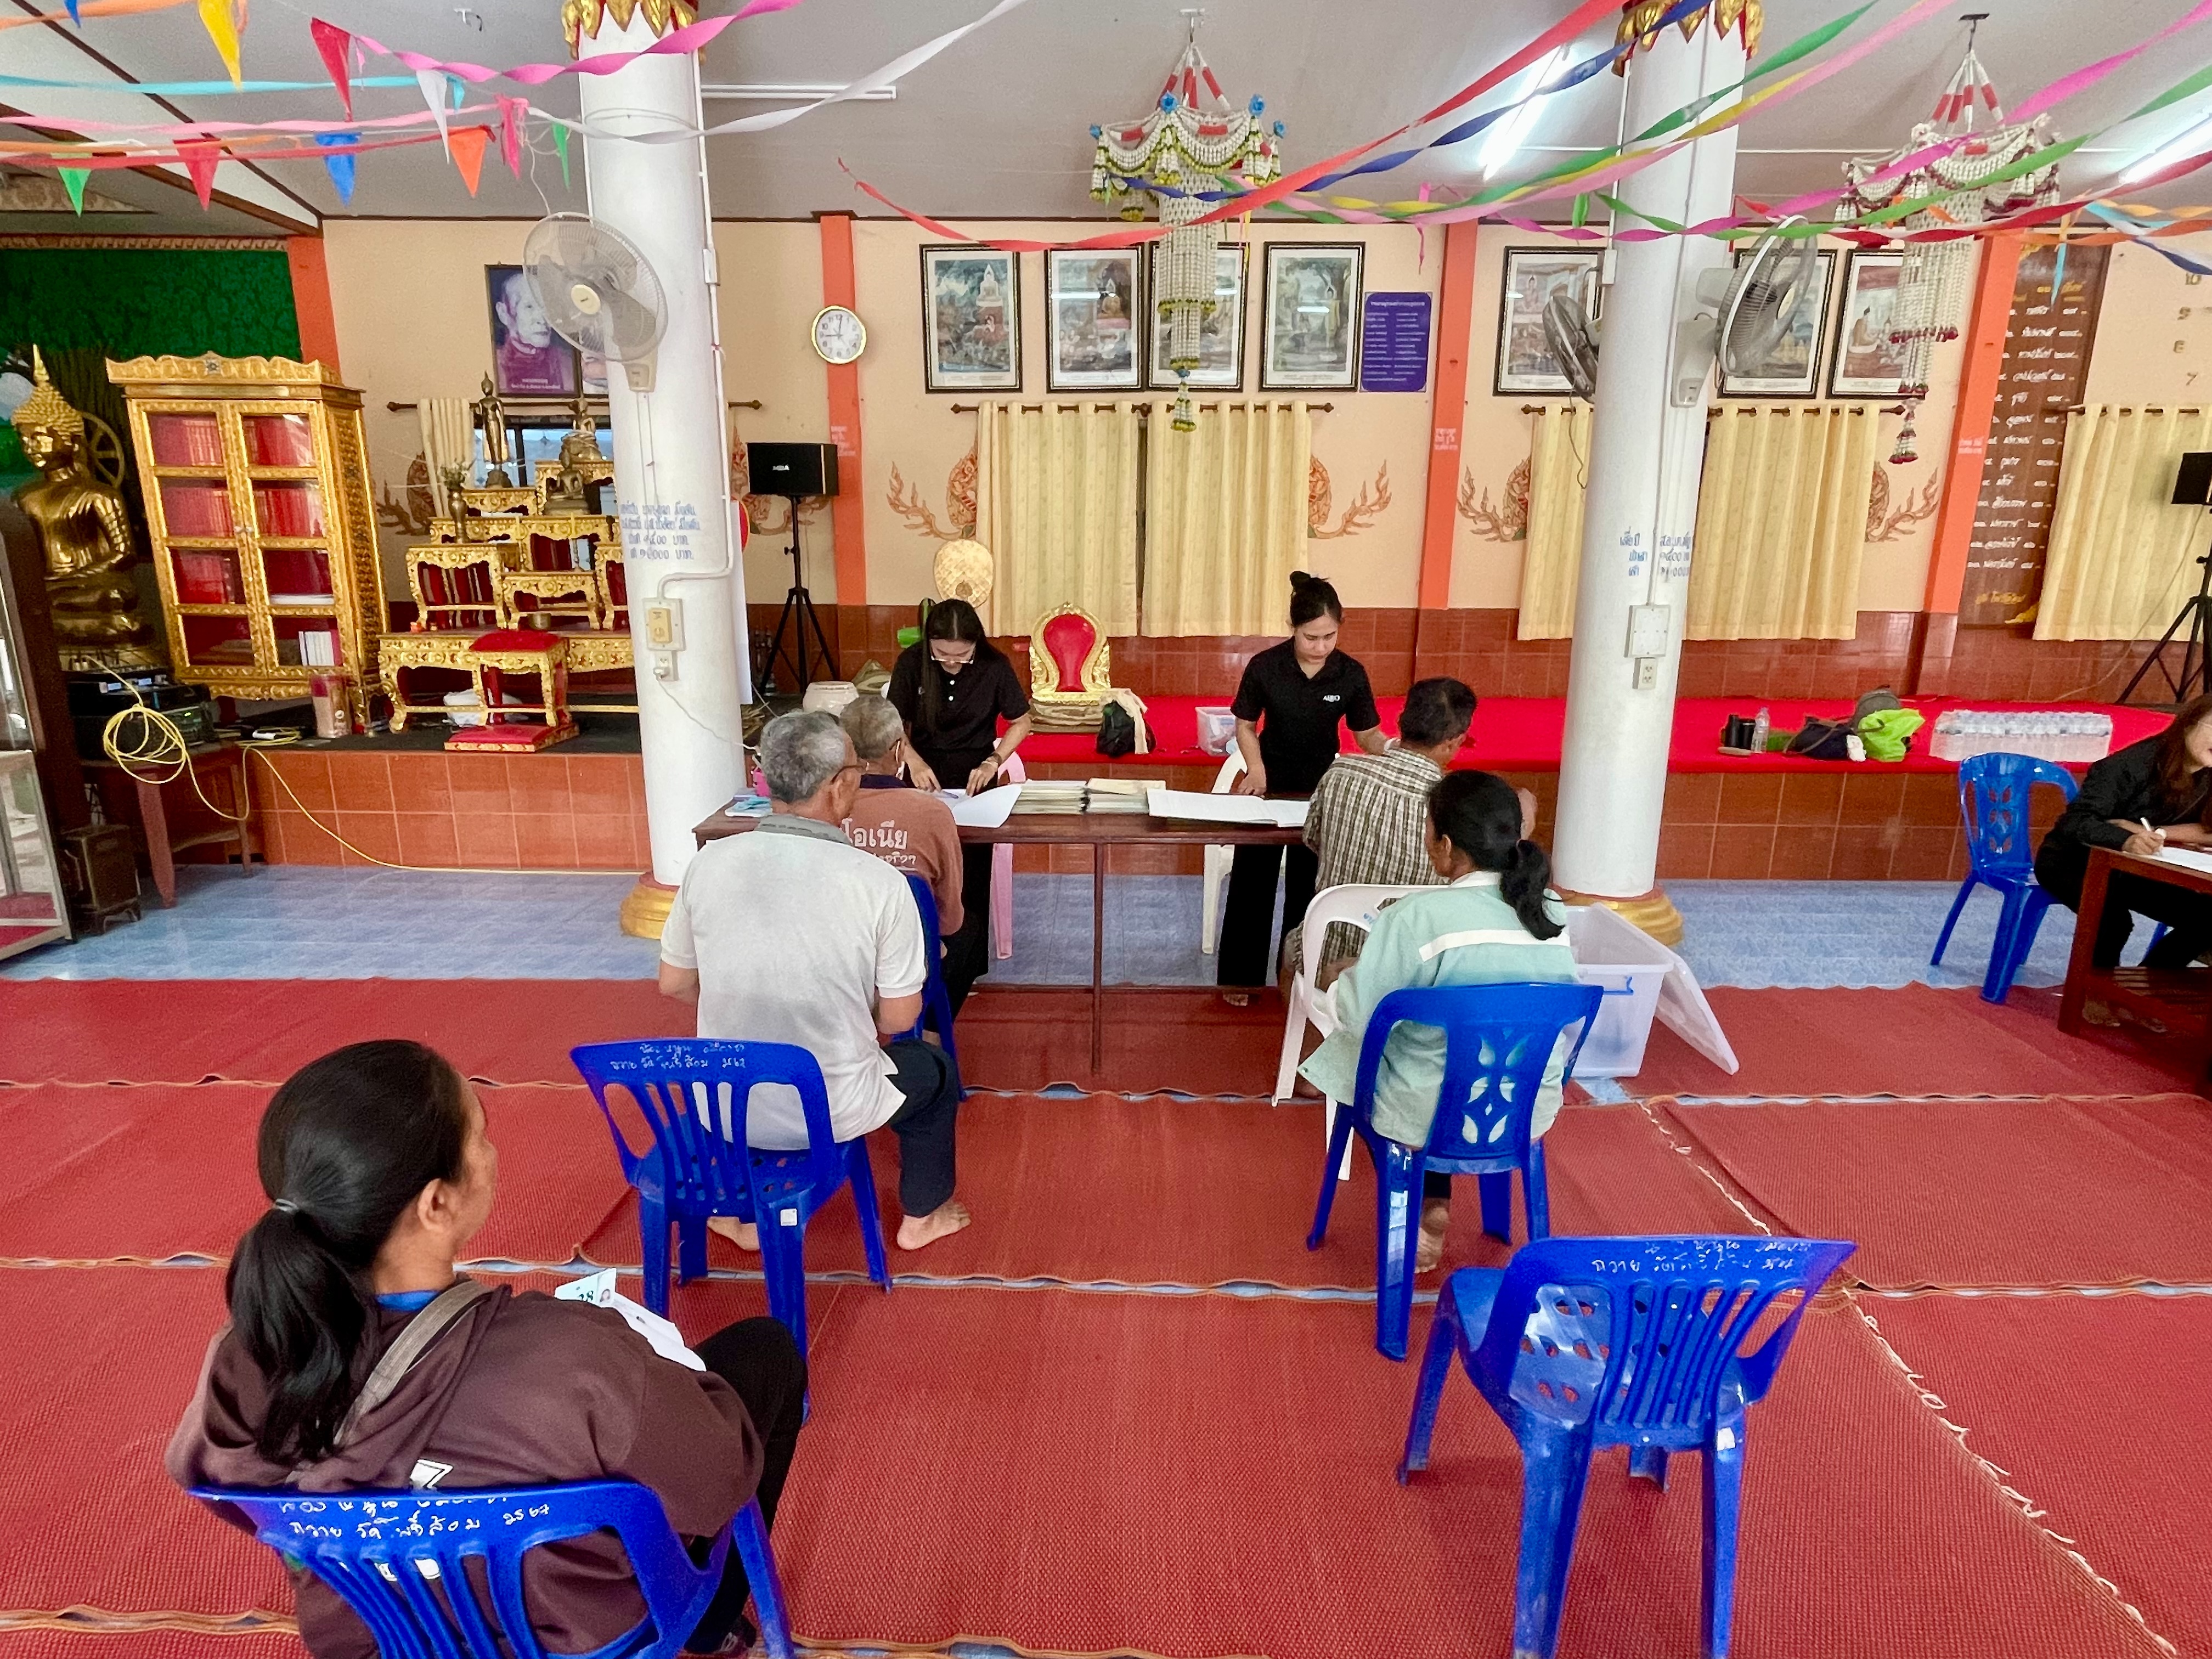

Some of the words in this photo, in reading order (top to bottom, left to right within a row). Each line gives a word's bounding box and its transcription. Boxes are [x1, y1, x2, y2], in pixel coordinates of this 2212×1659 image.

[2186, 371, 2198, 386] 7
[839, 817, 907, 849] โอเนีย
[503, 1504, 550, 1525] 2567
